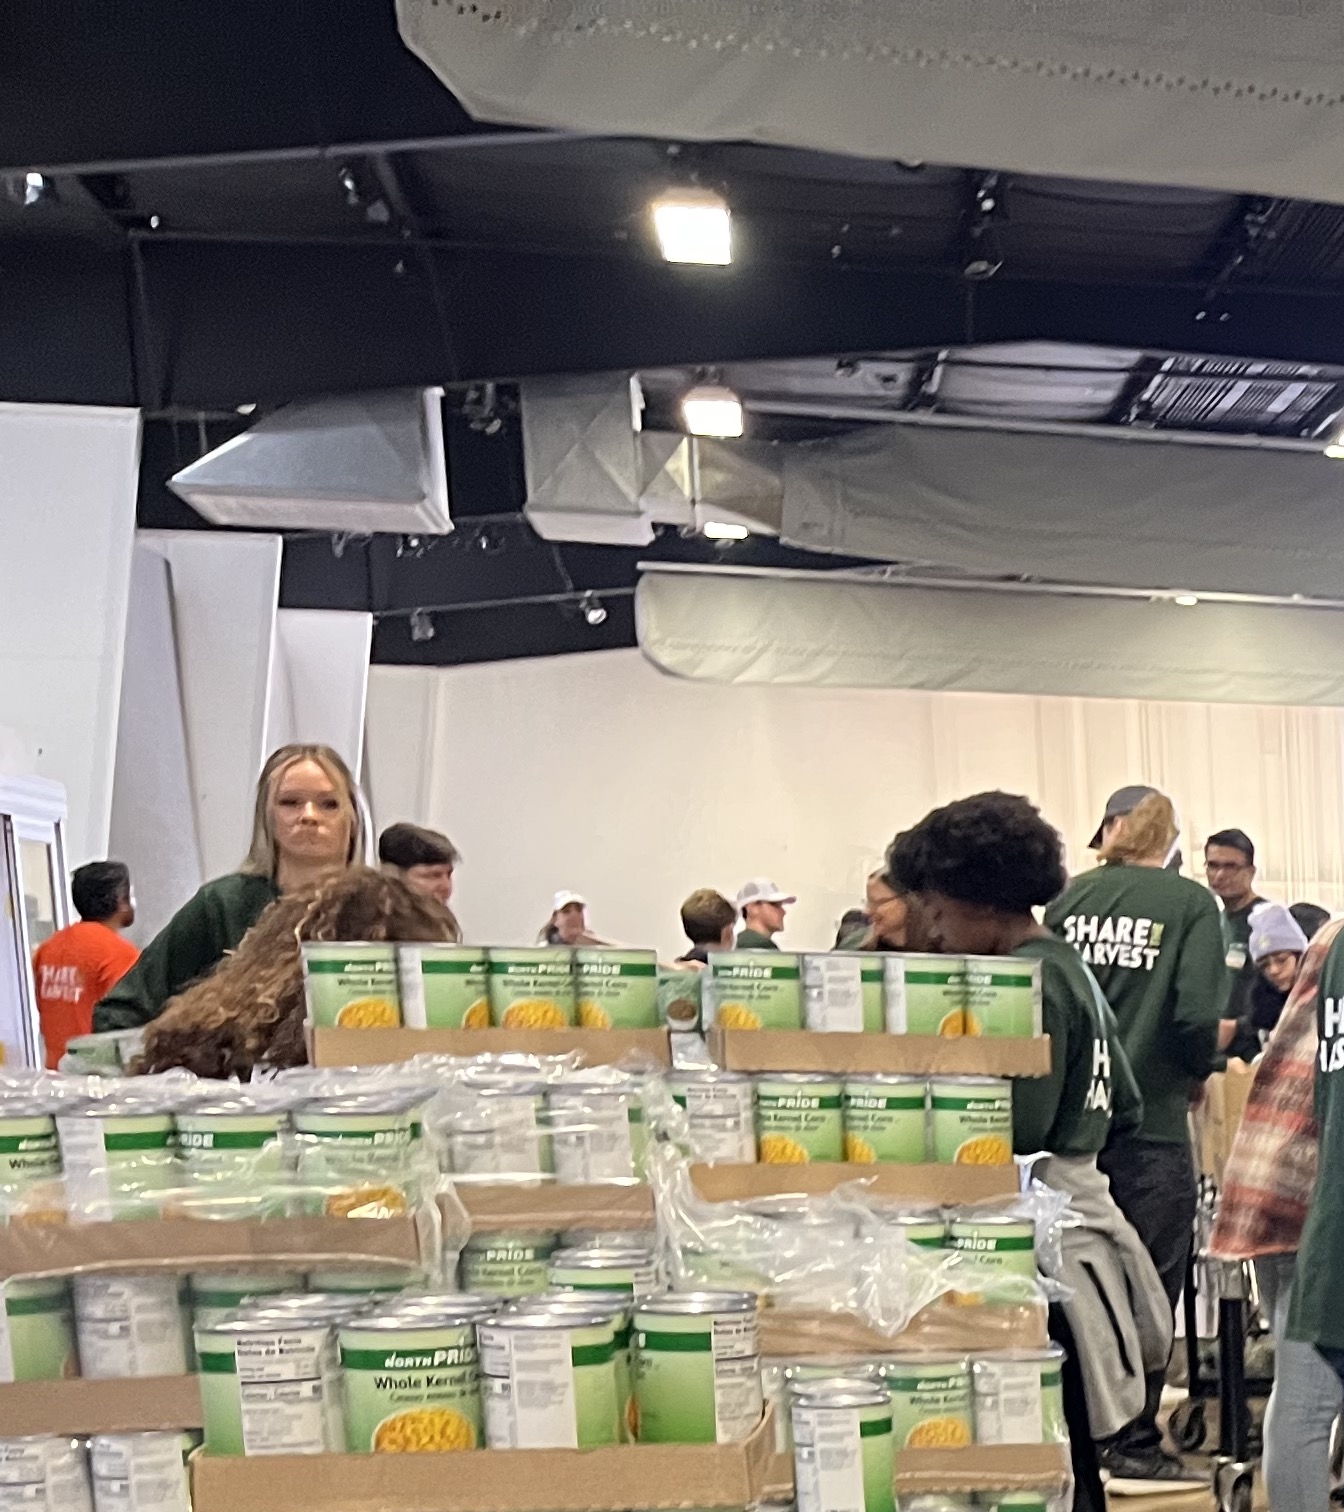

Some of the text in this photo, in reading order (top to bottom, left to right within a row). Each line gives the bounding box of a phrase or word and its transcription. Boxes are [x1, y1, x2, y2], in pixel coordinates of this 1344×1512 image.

[1063, 915, 1152, 946] SHARE
[1073, 942, 1160, 971] ARVEST
[777, 1089, 820, 1109] PRIDE
[957, 1230, 997, 1250] PRIDE
[486, 1241, 534, 1261] PRIDE
[385, 1351, 432, 1368] NORTH
[374, 1376, 421, 1389] Whole
